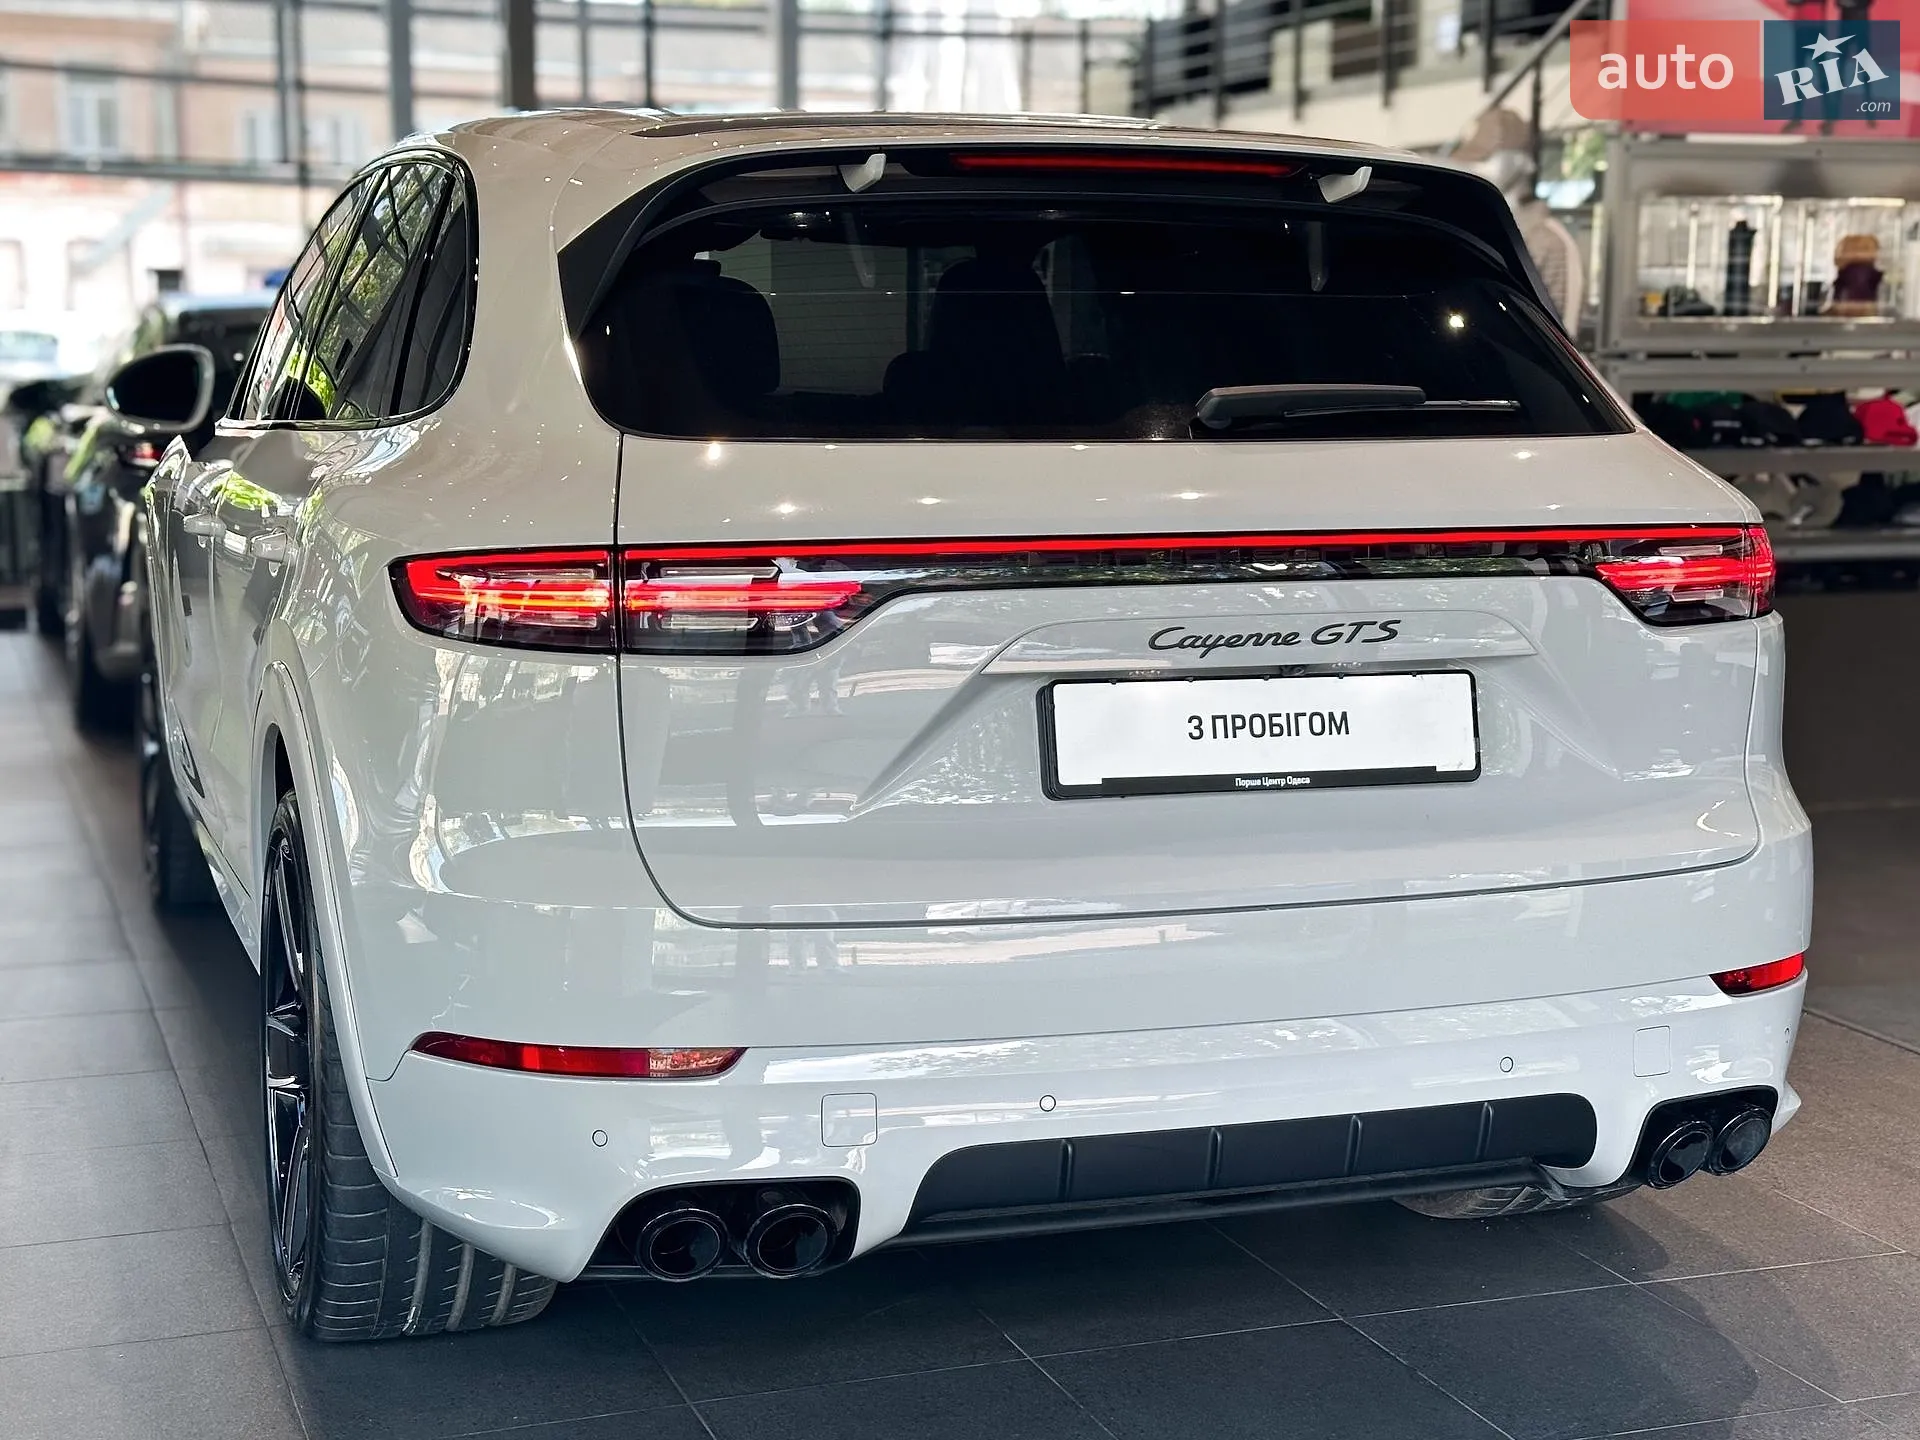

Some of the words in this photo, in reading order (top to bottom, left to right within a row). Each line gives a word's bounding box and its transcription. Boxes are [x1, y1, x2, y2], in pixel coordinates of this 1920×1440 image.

[1148, 626, 1301, 659] Cayenne
[1310, 619, 1402, 645] GTS
[1211, 711, 1350, 740] ПРОБІГОМ
